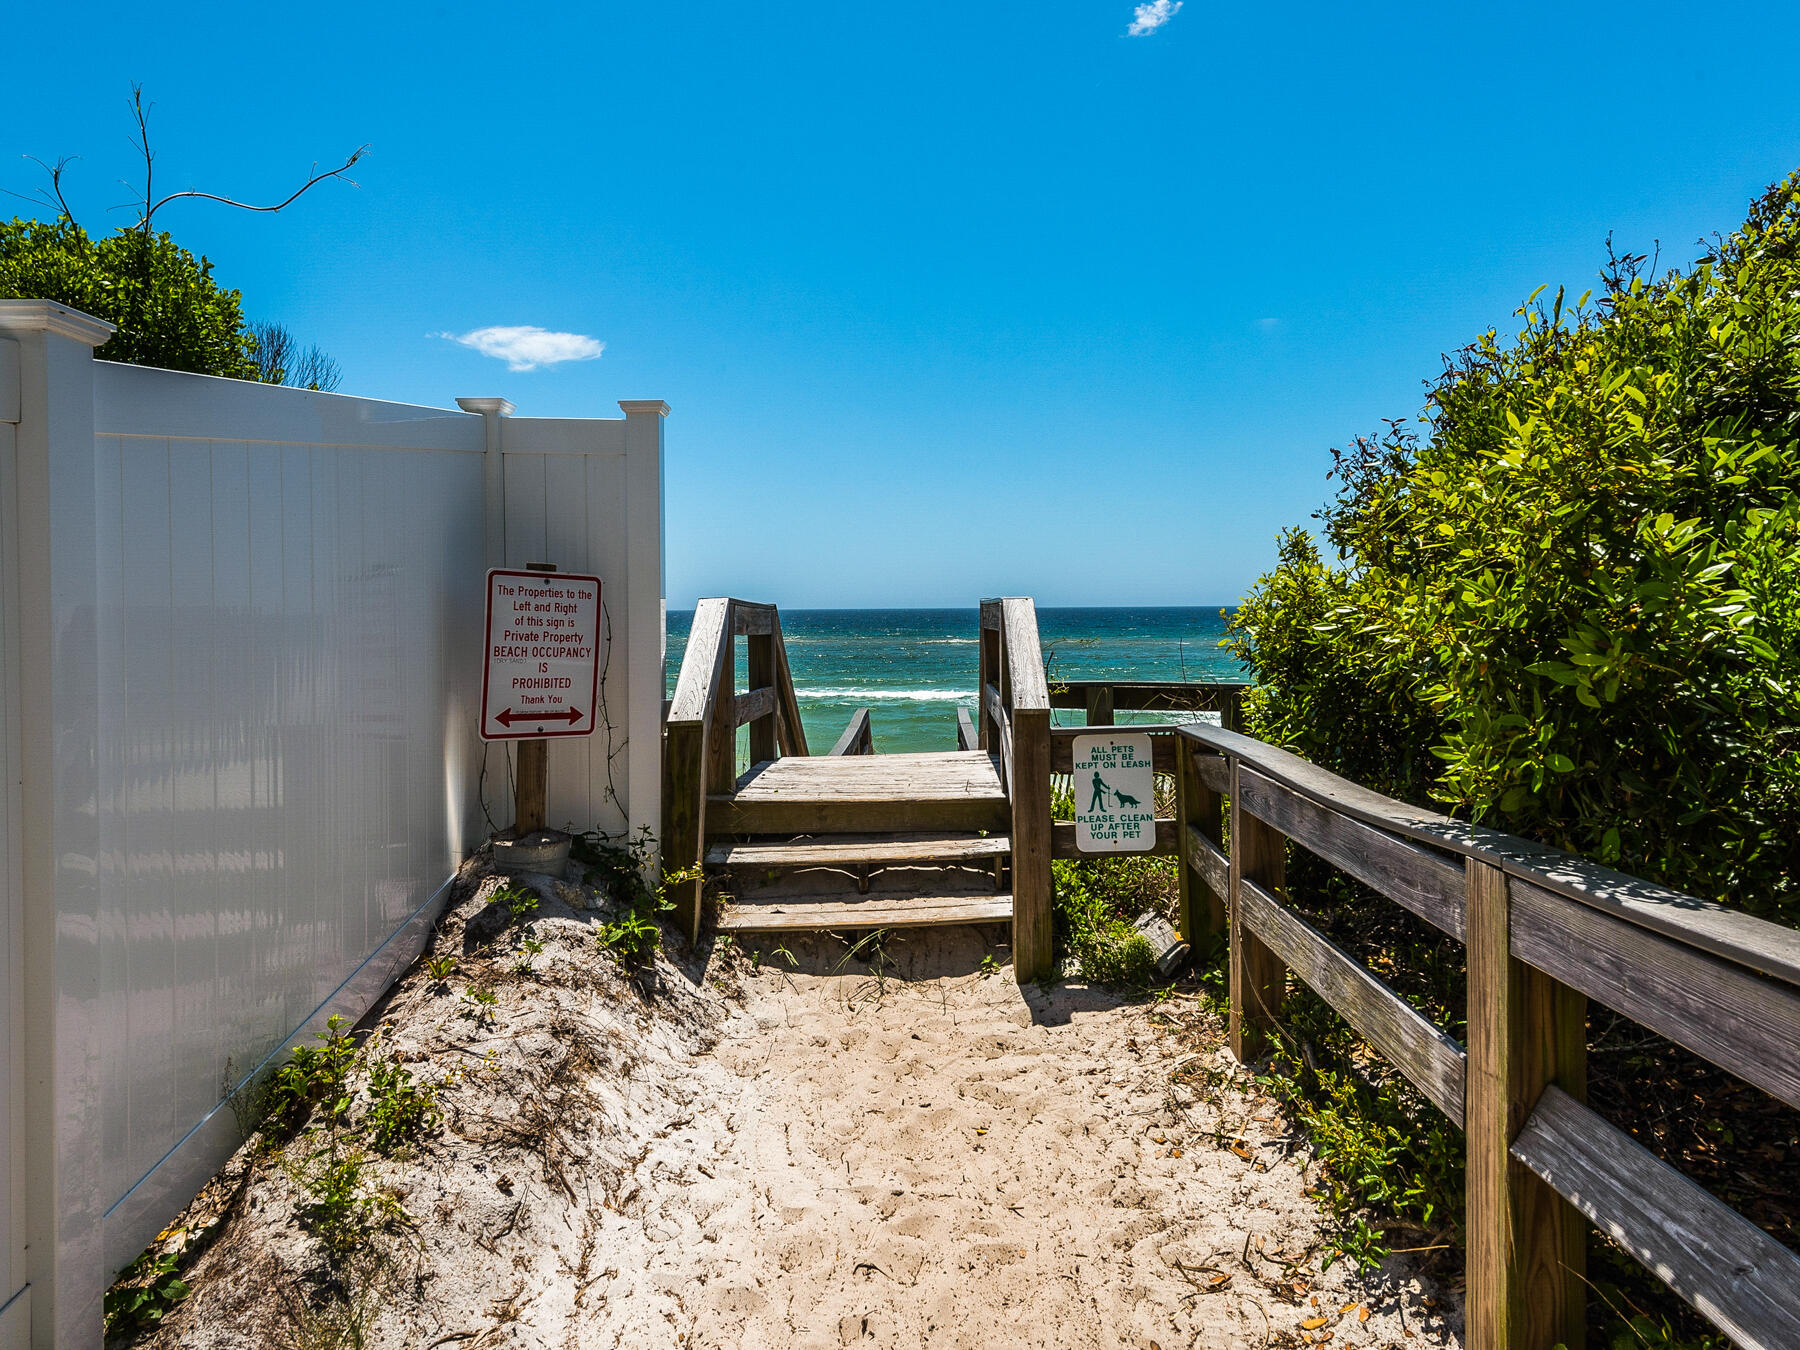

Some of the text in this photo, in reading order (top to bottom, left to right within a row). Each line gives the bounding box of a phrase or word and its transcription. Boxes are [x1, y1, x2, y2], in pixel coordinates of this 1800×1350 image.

[498, 585, 592, 599] The Properties to the
[514, 600, 578, 616] Left and Right
[514, 616, 574, 630] of this sign is
[504, 630, 584, 645] Private Property
[494, 646, 592, 658] BEACH OCCUPANCY
[538, 662, 548, 673] IS
[512, 678, 572, 688] PROHIBITED
[521, 694, 562, 704] Thank You
[1078, 814, 1114, 823] PLEASE
[1108, 822, 1140, 830] AFTER
[1090, 832, 1118, 840] YOUR
